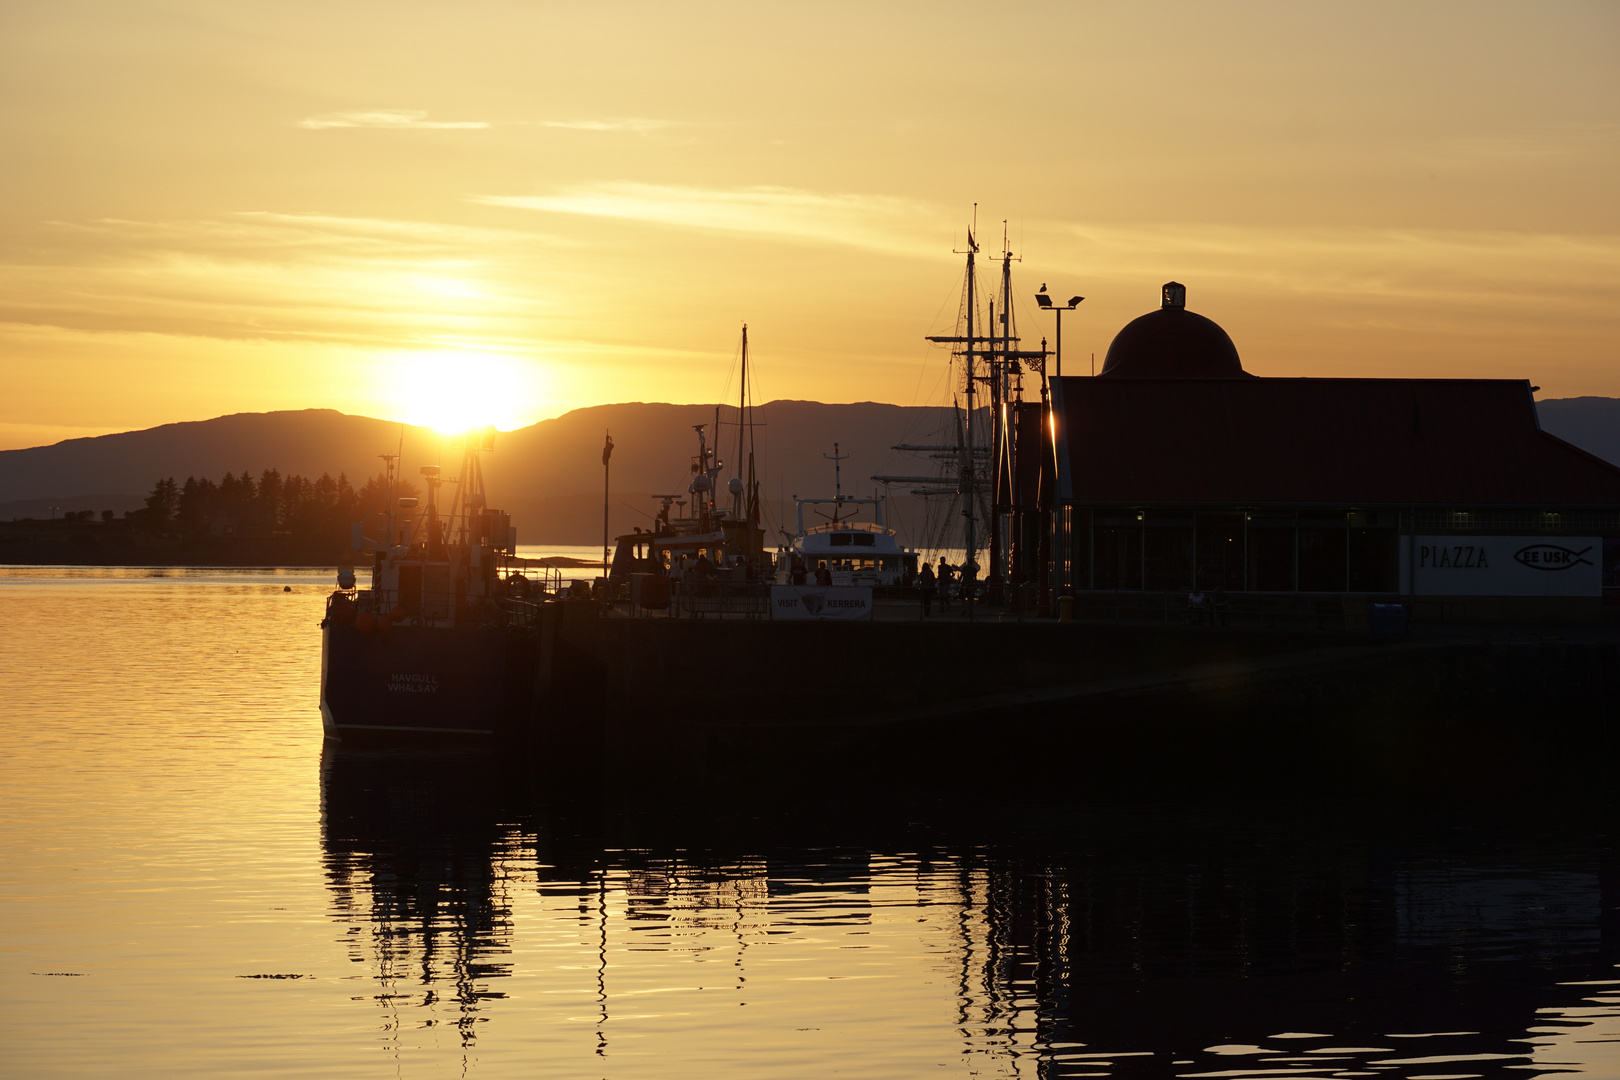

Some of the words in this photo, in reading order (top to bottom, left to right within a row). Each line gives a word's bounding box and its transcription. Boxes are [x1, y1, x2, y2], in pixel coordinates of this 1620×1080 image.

[1420, 546, 1489, 568] PIAZZA
[1523, 551, 1539, 563] EE
[1543, 551, 1572, 563] USK
[777, 599, 798, 608] VISIT
[827, 599, 866, 608] KERRERA
[392, 673, 438, 684] HAVGULL
[387, 683, 439, 693] WHALSAY
